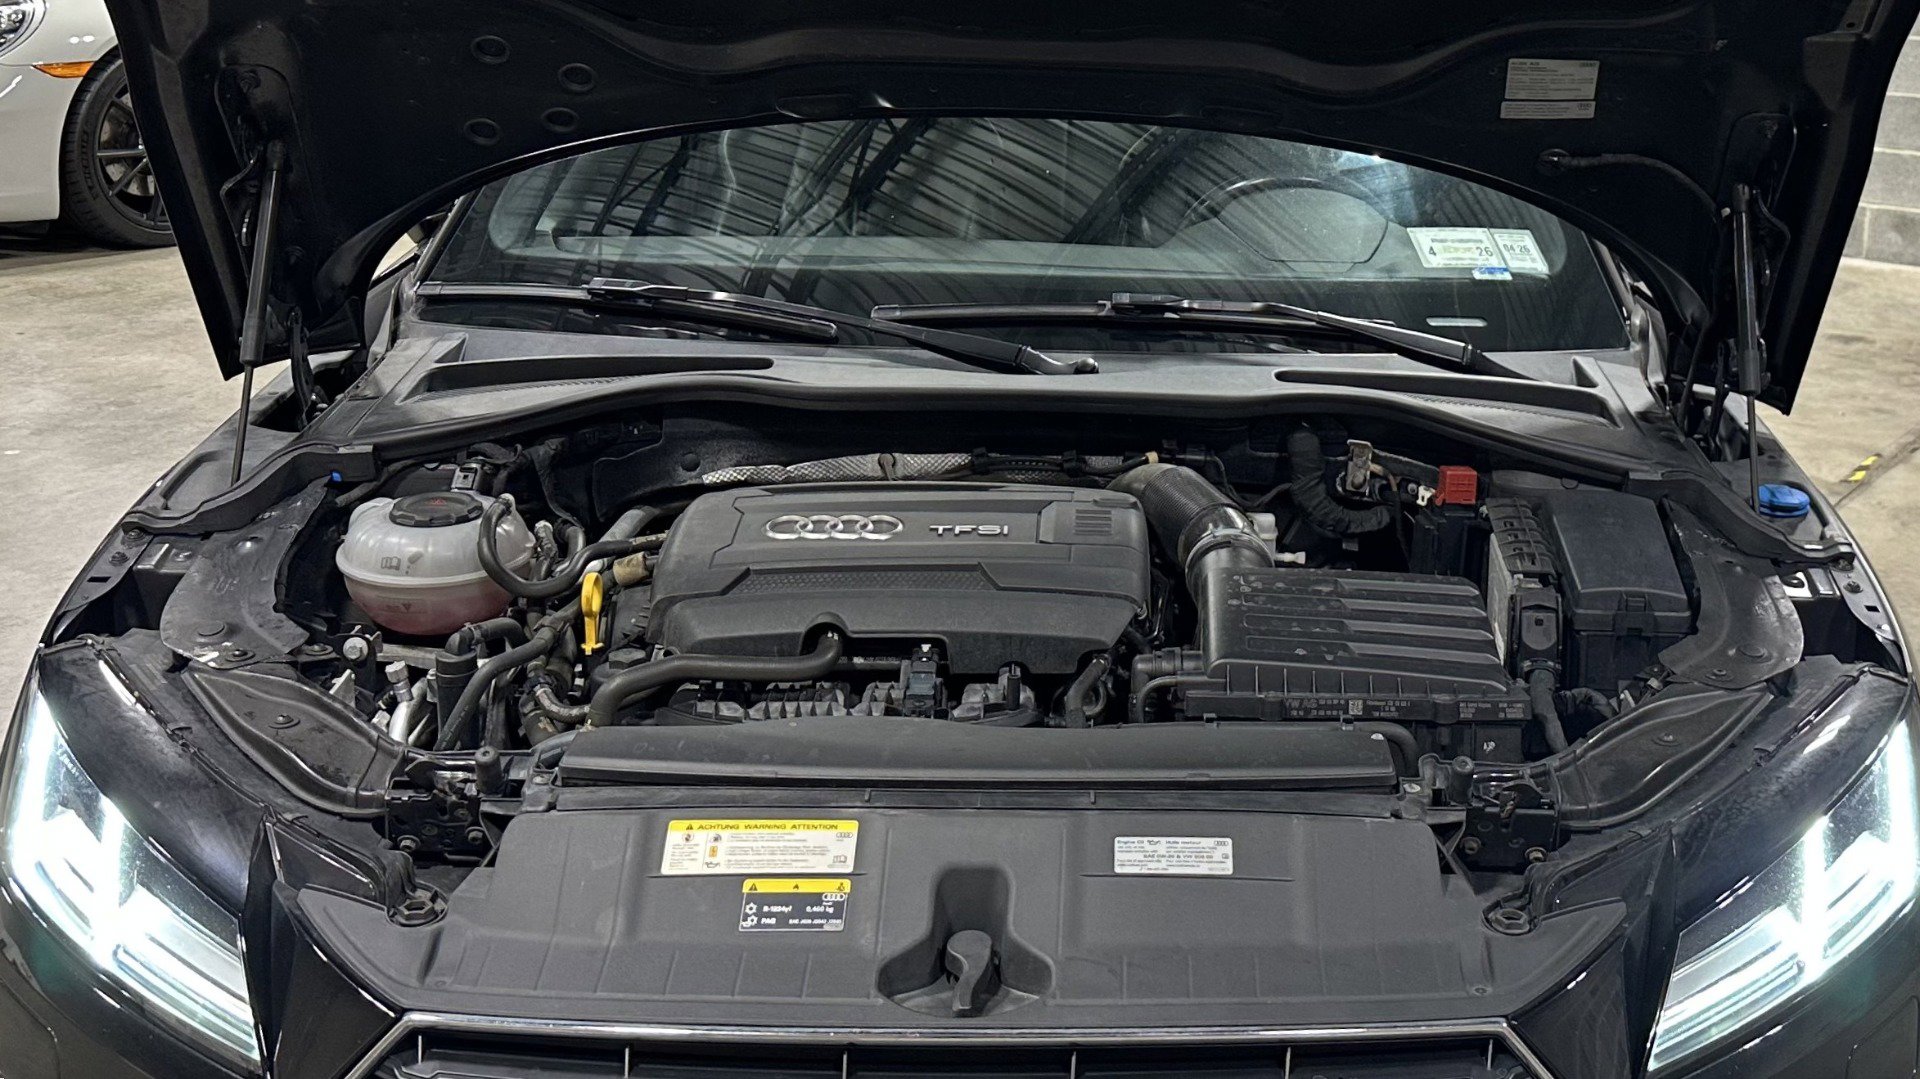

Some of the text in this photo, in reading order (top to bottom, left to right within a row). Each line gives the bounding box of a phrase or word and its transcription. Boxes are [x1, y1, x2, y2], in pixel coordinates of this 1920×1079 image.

[1428, 246, 1437, 256] 4
[1475, 246, 1494, 257] 26
[929, 524, 1009, 535] TFSI
